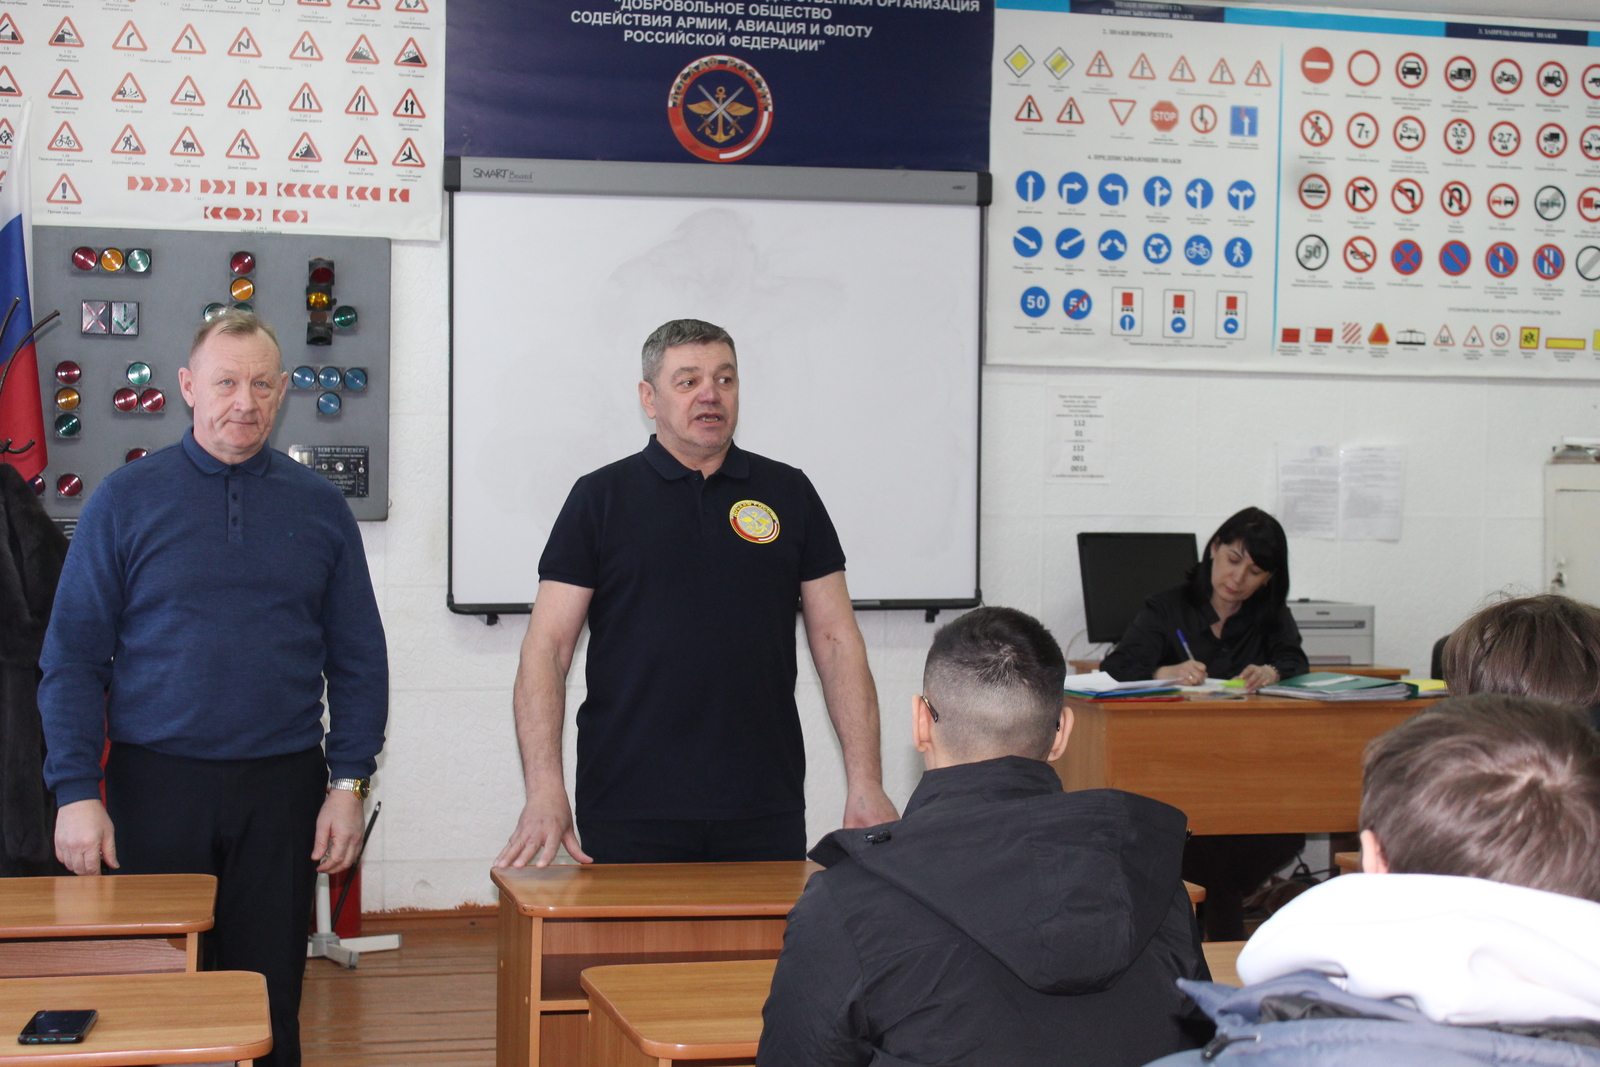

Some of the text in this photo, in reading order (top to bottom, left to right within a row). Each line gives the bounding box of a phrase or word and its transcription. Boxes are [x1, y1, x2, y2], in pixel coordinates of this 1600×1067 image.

[748, 4, 832, 19] ОБЩЕСТВО
[571, 10, 873, 38] СОДЕЙСТВИЯ АРМИИ, АВИАЦИЯ И ФЛОТУ
[624, 30, 726, 46] РОССИЙСКОЙ
[670, 57, 771, 107] ДОСААФ РОССИИ
[1153, 111, 1176, 121] STOP
[473, 168, 510, 178] SMART
[1304, 245, 1321, 259] 50
[1027, 295, 1046, 309] 50
[1496, 332, 1506, 340] 50
